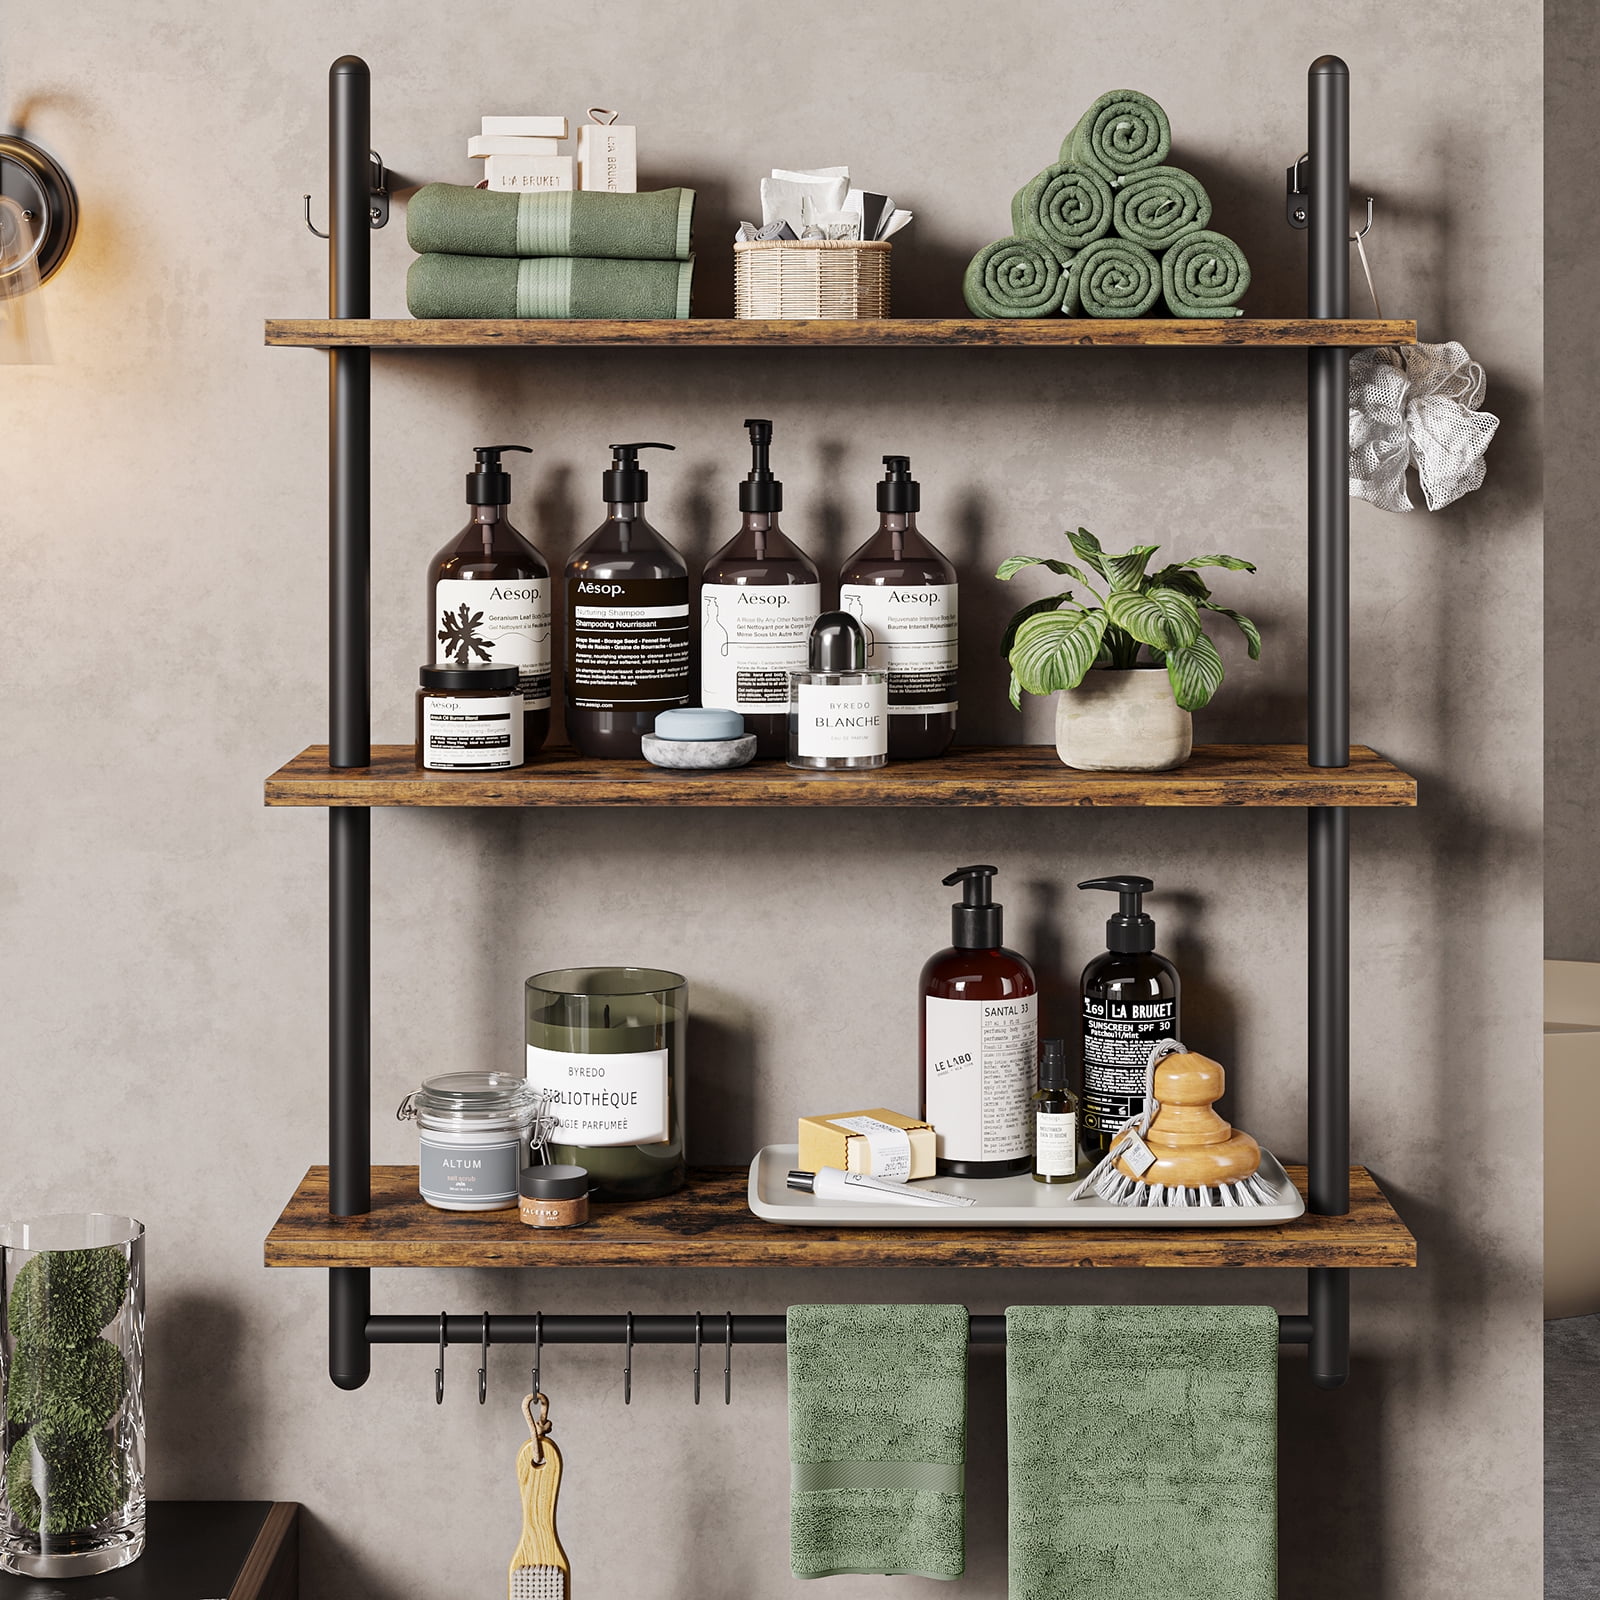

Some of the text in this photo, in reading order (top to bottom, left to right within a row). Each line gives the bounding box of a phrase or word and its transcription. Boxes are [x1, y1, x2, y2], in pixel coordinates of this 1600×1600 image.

[608, 157, 616, 192] BRUKE
[523, 176, 560, 186] BRUKET
[577, 581, 625, 597] Aēsop.
[609, 609, 645, 617] Shampoo
[576, 620, 614, 629] Shampooing
[816, 716, 880, 727] BLANCHE
[985, 1004, 1028, 1017] SANTAL 33
[1086, 1003, 1104, 1015] 169
[1132, 1002, 1173, 1018] BRUKET
[1088, 1020, 1170, 1032] SUNSCREEN SPF 30
[935, 1061, 946, 1072] LE
[946, 1053, 972, 1067] LABO
[568, 1067, 605, 1077] BYREDO
[442, 1159, 482, 1168] ALTUM
